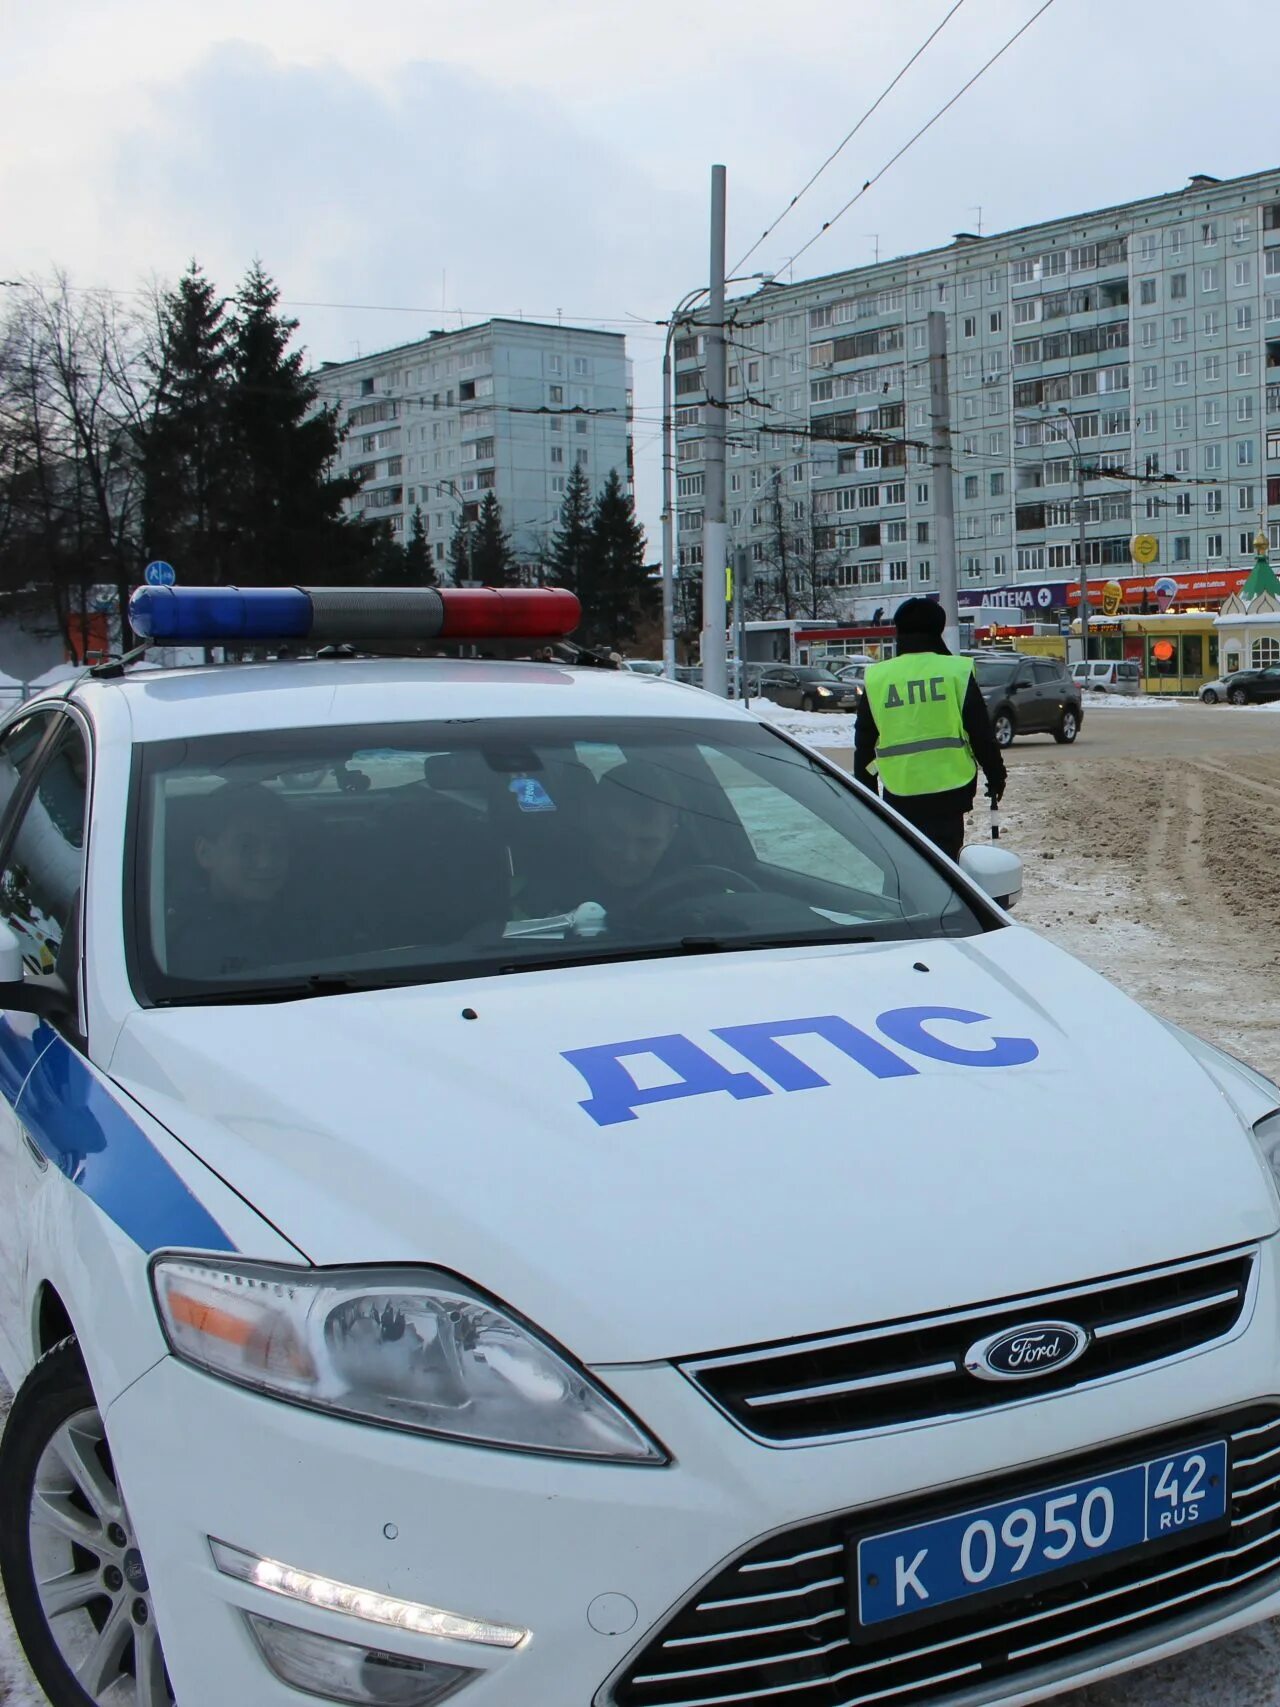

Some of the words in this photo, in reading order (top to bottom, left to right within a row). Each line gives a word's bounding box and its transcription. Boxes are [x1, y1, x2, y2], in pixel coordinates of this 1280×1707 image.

[981, 590, 1034, 608] АПТЕКА
[884, 676, 946, 709] ДПС
[559, 1006, 1039, 1126] ДПС
[1008, 1334, 1060, 1367] Ford
[1154, 1455, 1206, 1507] 42
[1160, 1503, 1199, 1530] RUS
[960, 1486, 1115, 1583] 0950
